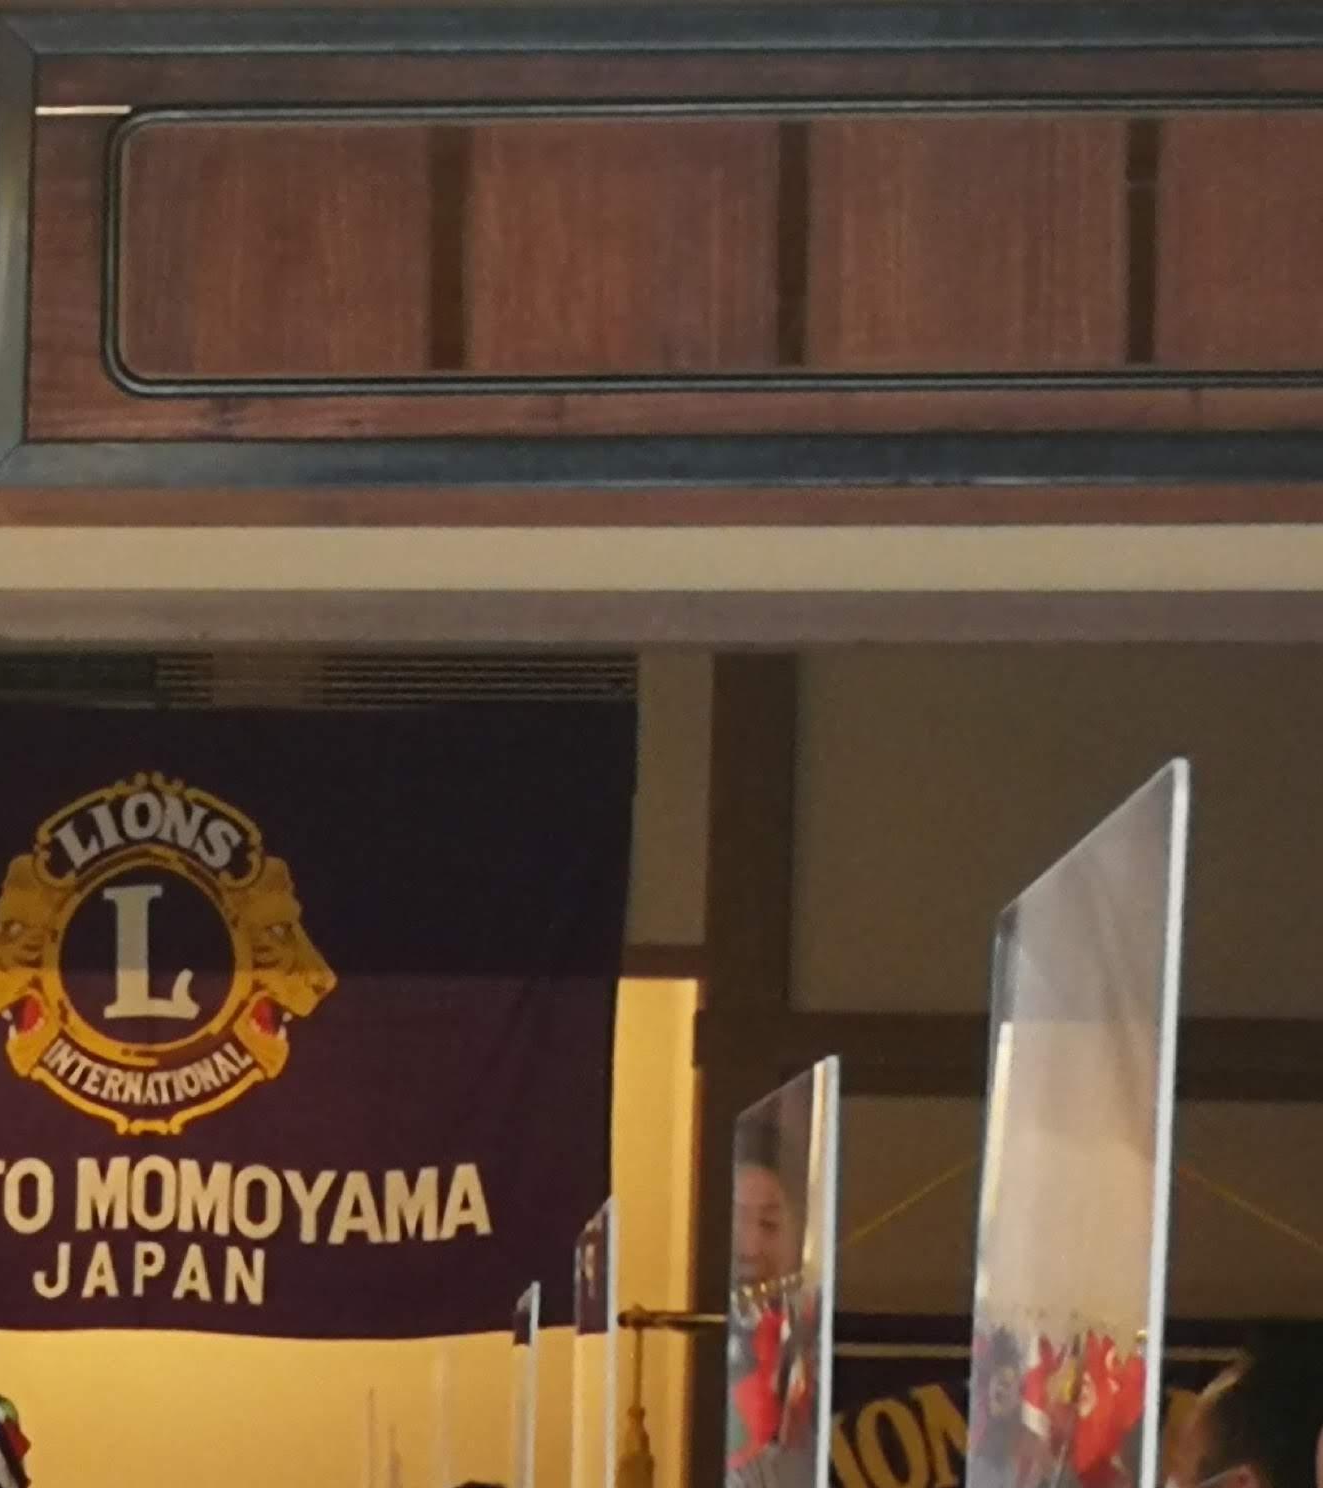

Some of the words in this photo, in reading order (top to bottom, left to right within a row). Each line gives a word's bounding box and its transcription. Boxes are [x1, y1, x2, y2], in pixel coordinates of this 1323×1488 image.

[54, 791, 244, 869] LIONS
[102, 884, 201, 1020] L
[42, 1037, 254, 1106] INTERNATIONAL
[75, 1153, 493, 1246] MOMOYAMA
[33, 1240, 267, 1306] JAPAN
